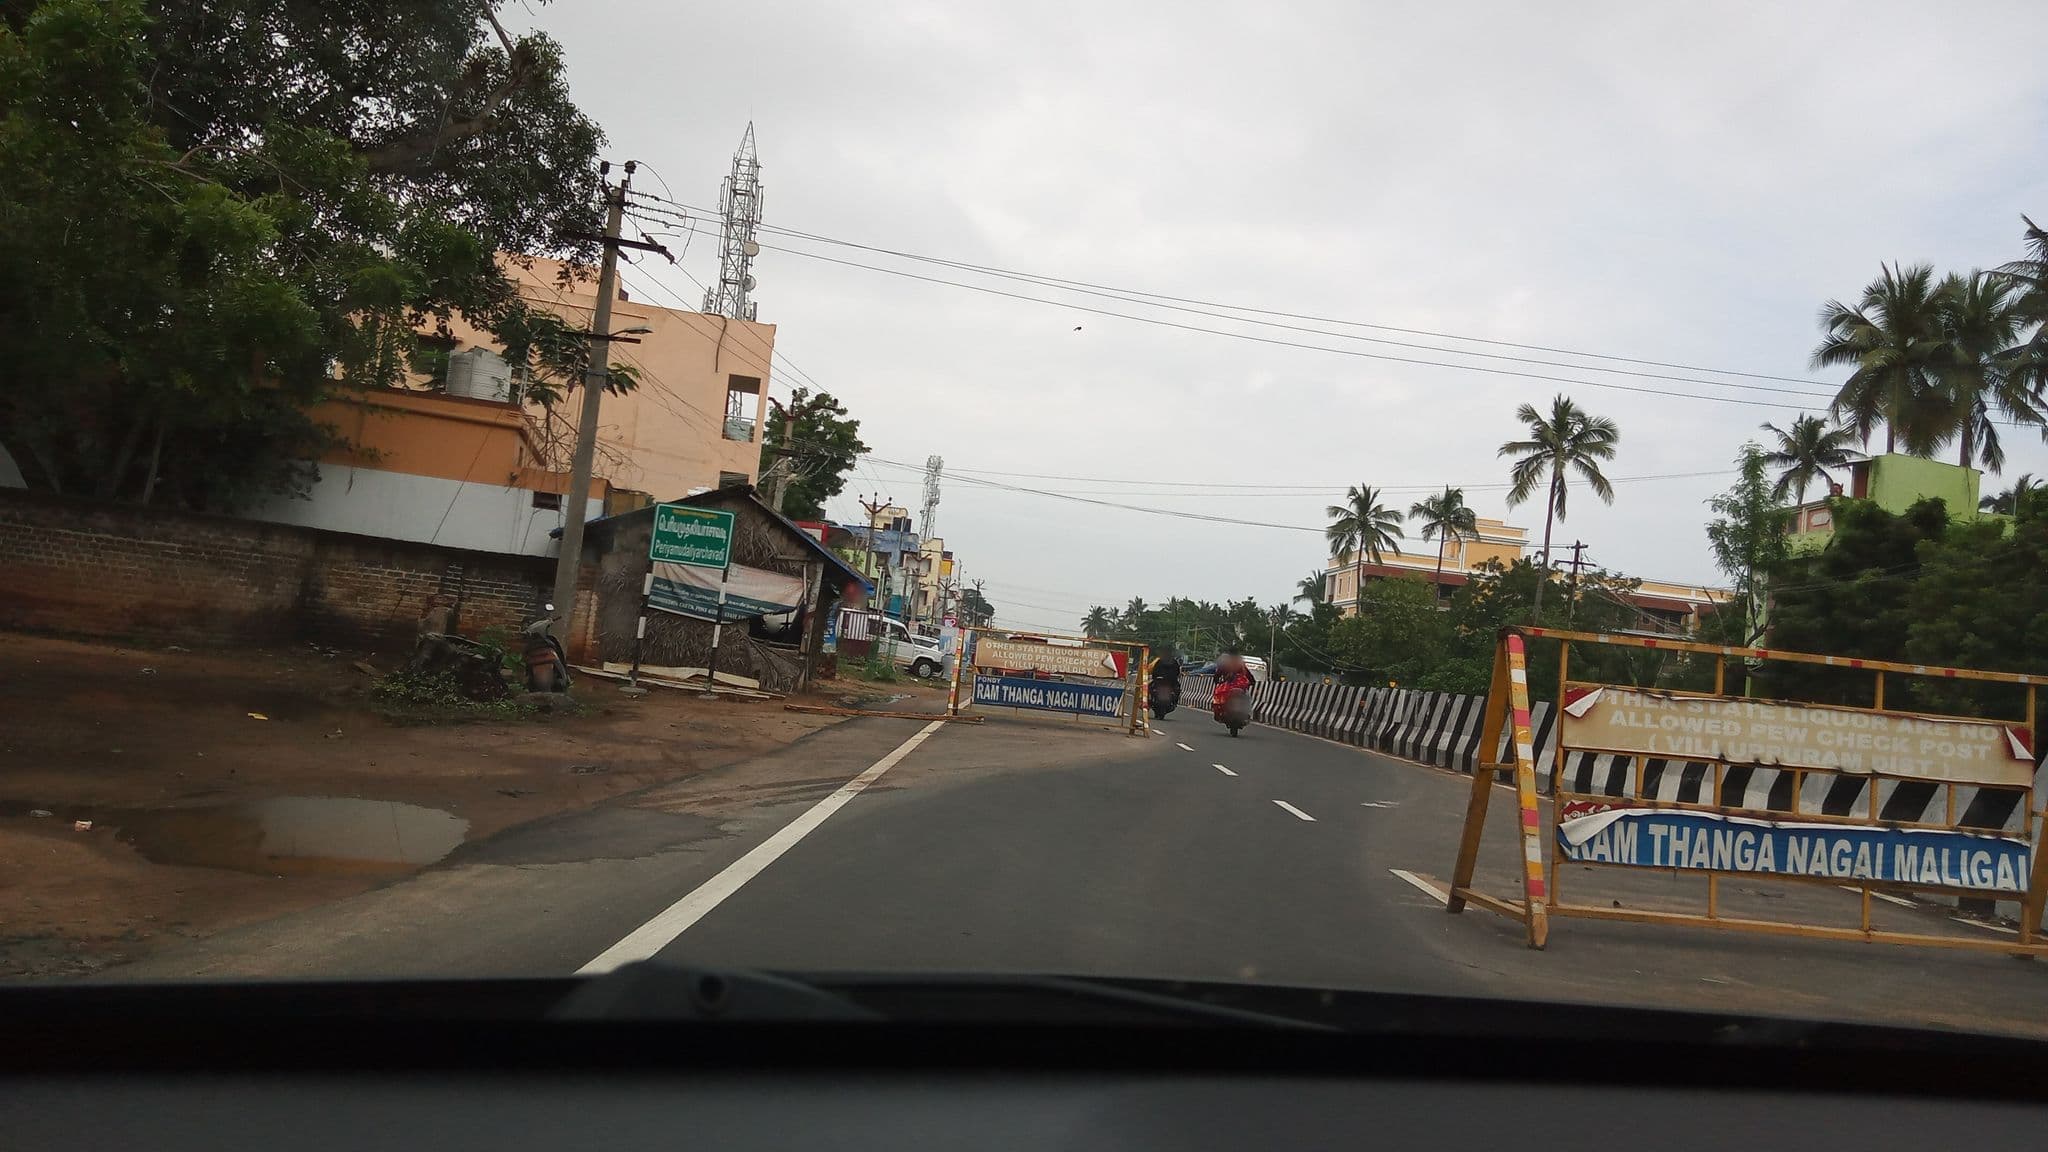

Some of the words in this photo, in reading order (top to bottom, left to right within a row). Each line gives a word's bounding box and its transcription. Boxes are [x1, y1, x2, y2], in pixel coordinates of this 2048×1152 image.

[986, 641, 1015, 651] OTHER
[1017, 644, 1045, 654] STATE
[1047, 646, 1079, 657] LIQUOR
[1080, 649, 1099, 659] ARE
[992, 651, 1032, 661] ALLOWED
[1056, 657, 1087, 667] CHECK
[977, 683, 1000, 701] RAM
[1003, 686, 1044, 706] THANGA
[1047, 690, 1079, 709] NAGAI
[1081, 694, 1118, 714] MALIGA
[1609, 710, 1742, 737] ALLOWED
[1817, 729, 1911, 753] CHECK
[1919, 739, 1992, 761] POST
[1784, 703, 1889, 731] LIQUOR
[1897, 717, 1950, 737] ARE
[1648, 823, 1776, 873] THANGA
[1786, 835, 1884, 881] NAGAI
[1894, 843, 2028, 892] MALIGAI
